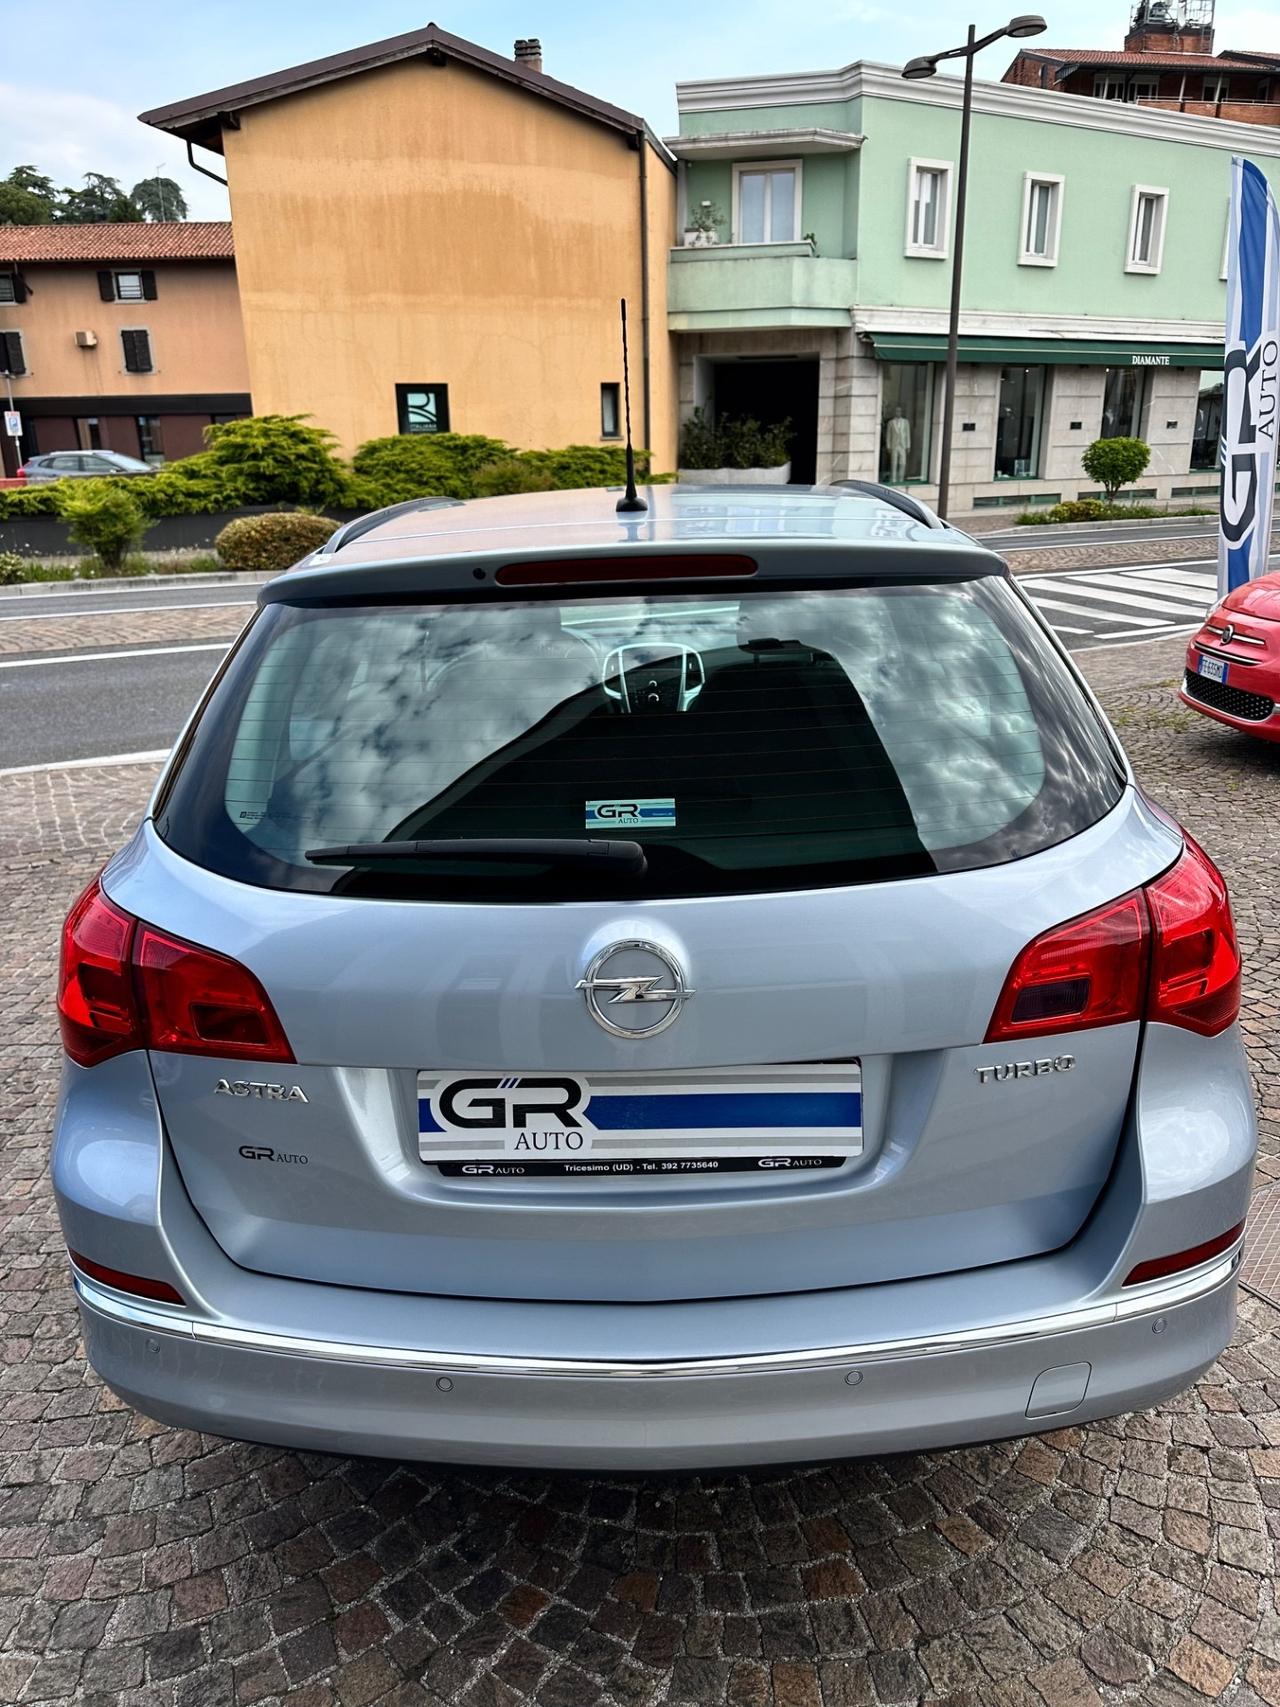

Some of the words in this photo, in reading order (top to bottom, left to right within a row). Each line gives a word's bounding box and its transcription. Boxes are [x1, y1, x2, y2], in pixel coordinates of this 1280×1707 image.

[1132, 355, 1170, 366] DIAMANTE
[1258, 340, 1279, 441] AUTO
[1220, 344, 1262, 543] GR
[597, 803, 639, 818] GR
[975, 1054, 1077, 1084] TURBO
[214, 1078, 309, 1103] ASTRA
[439, 1077, 583, 1128] GR
[514, 1132, 584, 1150] AUTO
[239, 1145, 275, 1161] GR
[276, 1154, 309, 1165] AUTO
[758, 1157, 792, 1168] GR
[793, 1158, 823, 1167] AUTO
[462, 1164, 494, 1174] GR
[495, 1166, 526, 1174] AUTO
[564, 1163, 610, 1172] Tricesimo
[612, 1163, 634, 1172] (UD)
[642, 1162, 658, 1171] Tel.
[661, 1161, 678, 1170] 392
[680, 1160, 719, 1170] 7735640
